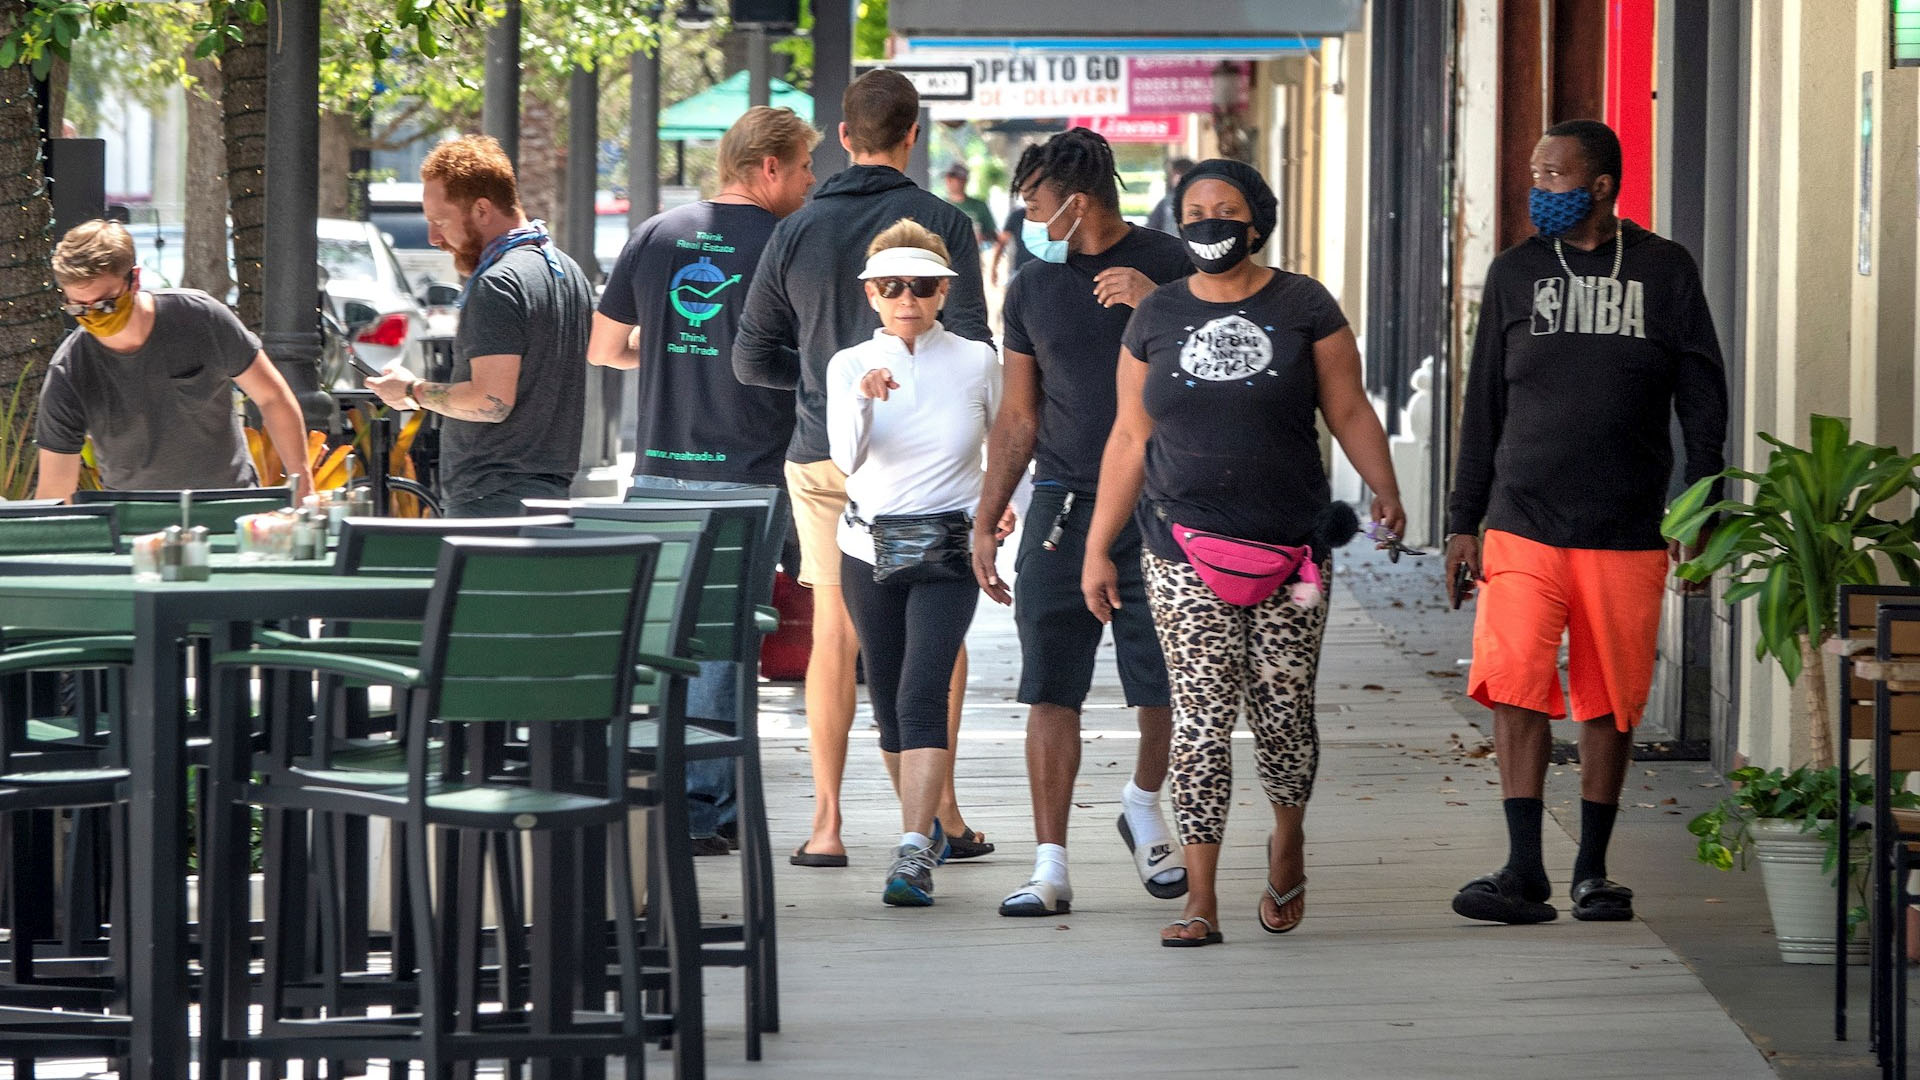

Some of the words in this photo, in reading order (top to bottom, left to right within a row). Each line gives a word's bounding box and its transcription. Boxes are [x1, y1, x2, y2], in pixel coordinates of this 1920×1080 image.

[975, 57, 1036, 83] OPEN
[1046, 56, 1076, 82] TO
[1086, 56, 1120, 82] GO
[1024, 86, 1119, 106] DELIVERY
[696, 231, 724, 242] Think
[676, 239, 699, 250] Real
[702, 242, 735, 254] Estate
[1564, 276, 1646, 338] NBA
[680, 332, 707, 343] Think
[667, 343, 688, 354] Real
[689, 345, 719, 356] Trade
[645, 449, 726, 462] www.realtrade.io
[1151, 844, 1170, 857] NIKE
